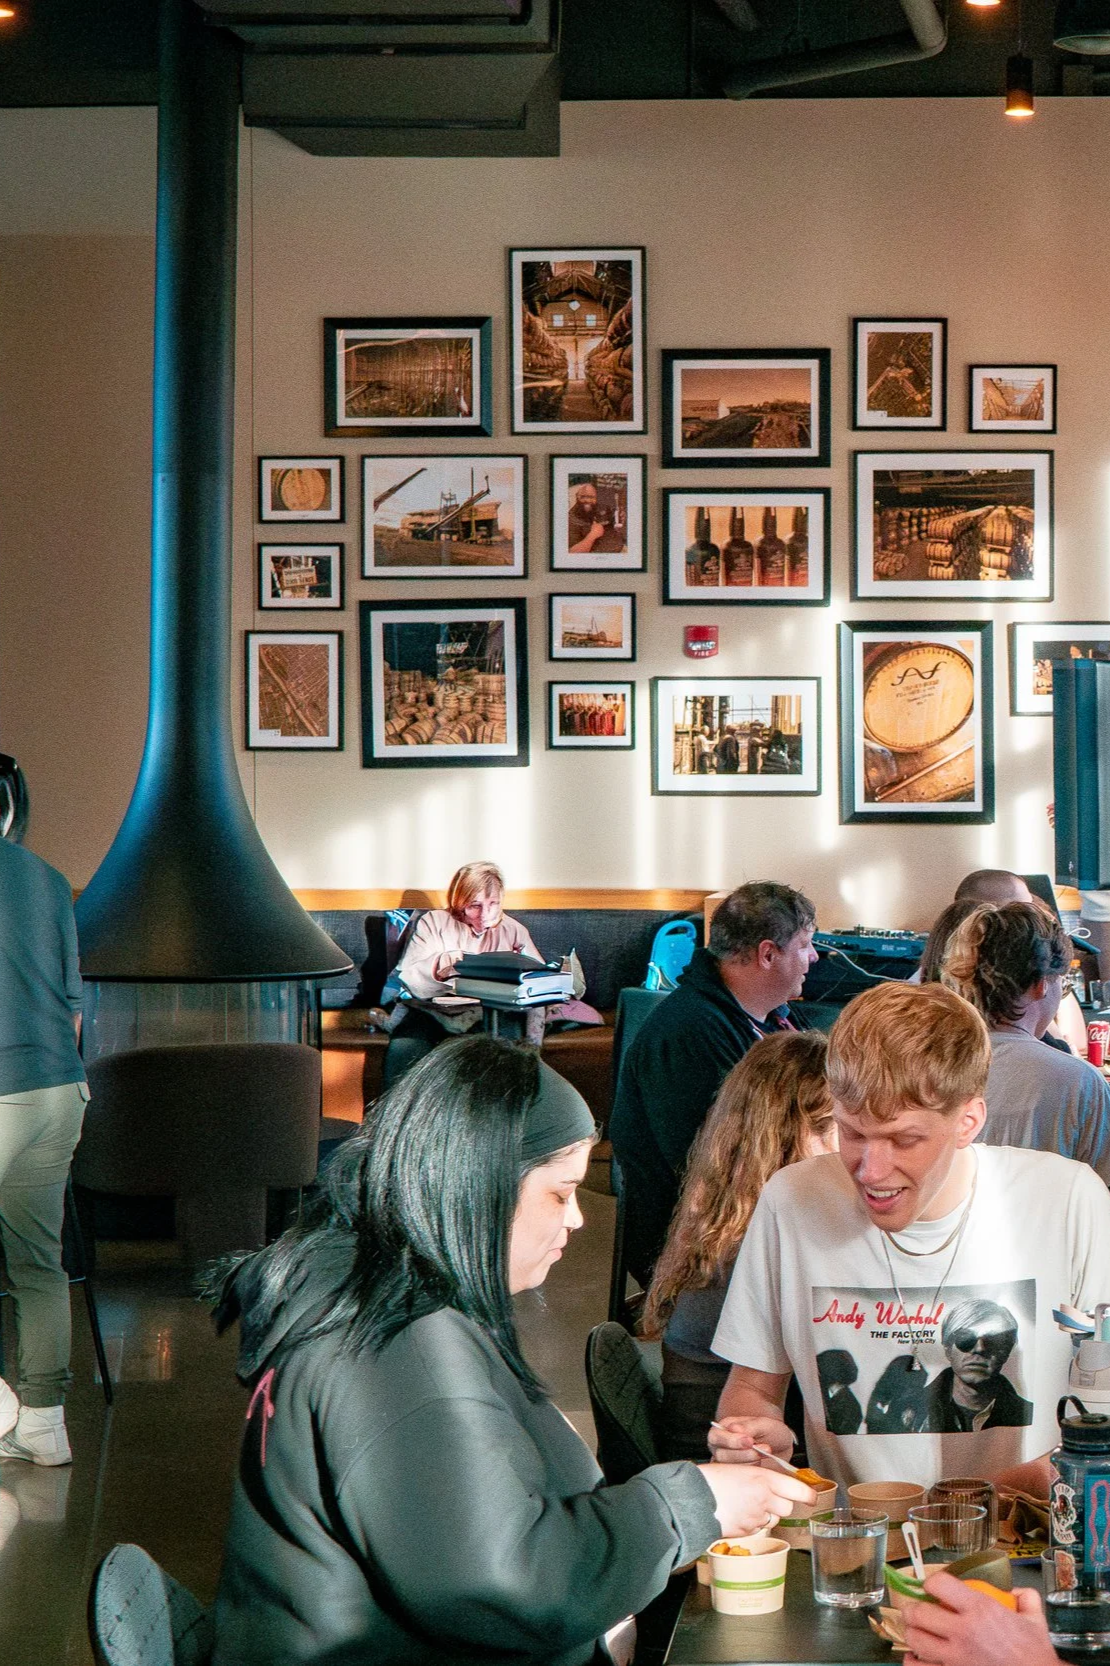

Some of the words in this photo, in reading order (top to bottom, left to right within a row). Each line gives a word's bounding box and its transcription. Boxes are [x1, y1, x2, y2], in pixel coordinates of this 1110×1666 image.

[813, 1299, 866, 1330] Andy
[875, 1301, 945, 1325] Warhol
[870, 1331, 889, 1339] THE
[891, 1330, 935, 1339] FACTORY
